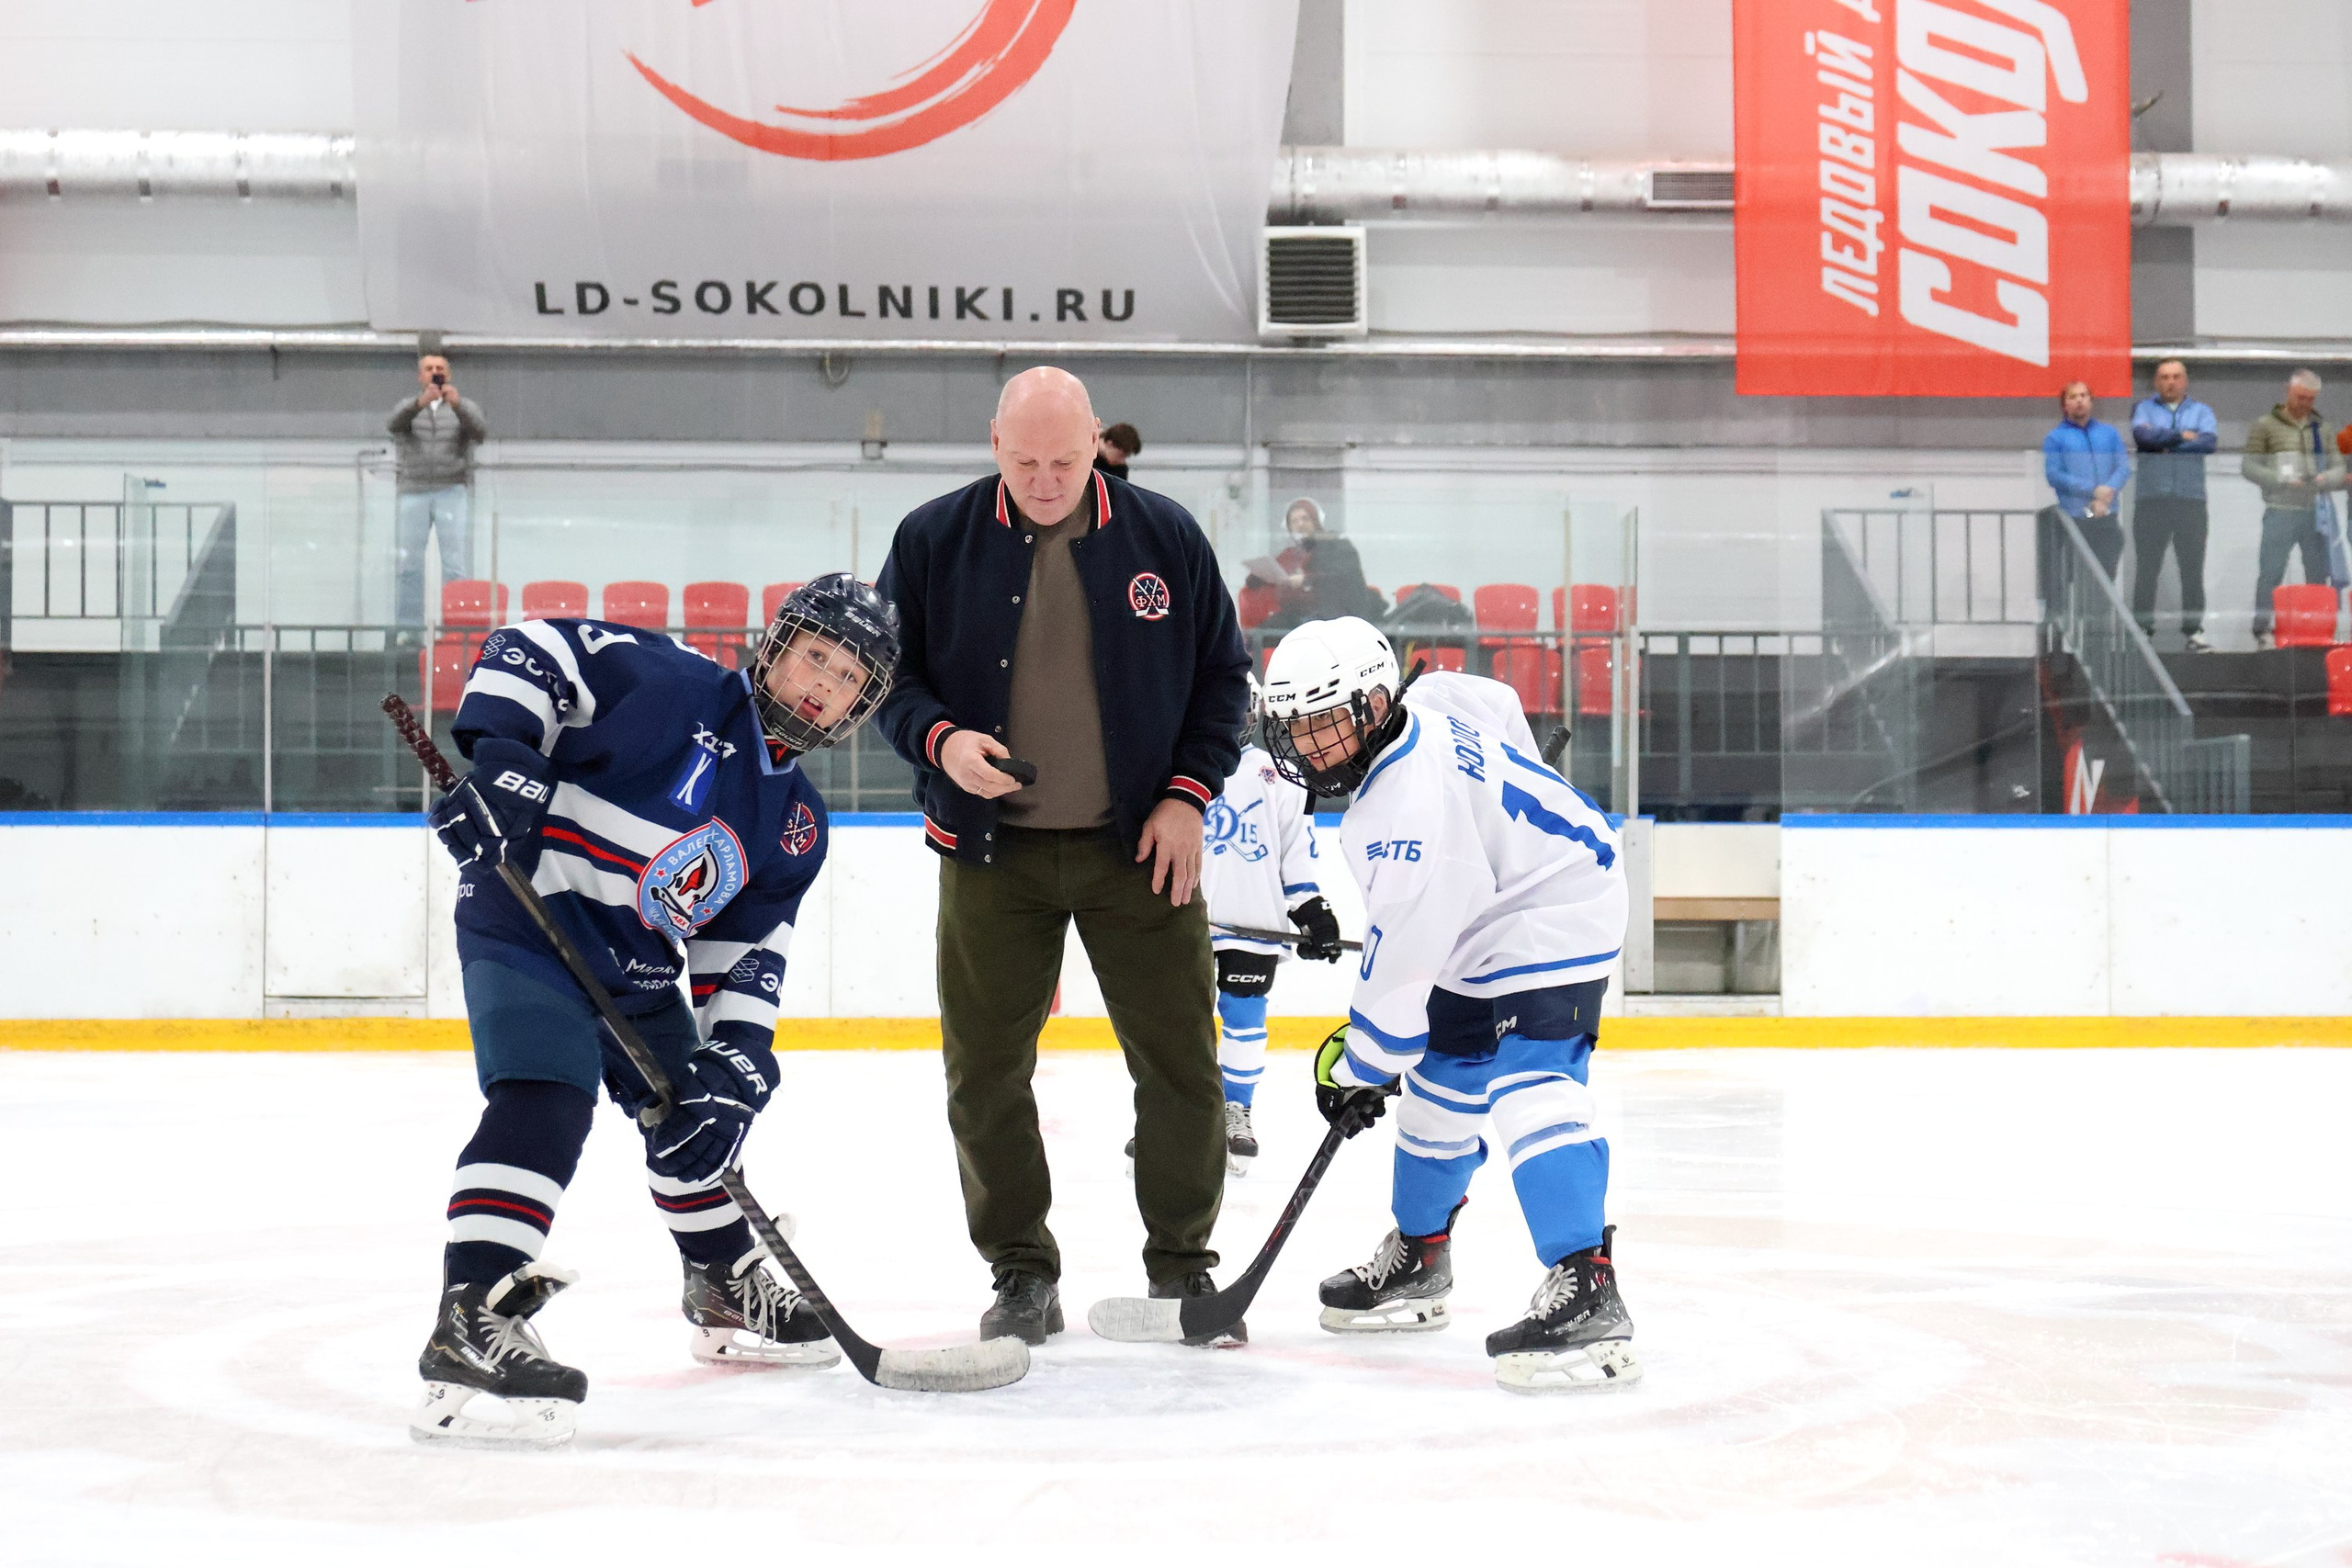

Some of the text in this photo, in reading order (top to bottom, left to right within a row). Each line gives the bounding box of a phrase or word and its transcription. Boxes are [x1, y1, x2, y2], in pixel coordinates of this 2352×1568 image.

[1804, 29, 1884, 318] ЛЕДОВЫЙ
[534, 279, 1136, 322] LD-SOKOLNIKI.RU
[1135, 593, 1166, 607] ФХМ
[1360, 661, 1385, 678] CCM
[1268, 693, 1296, 703] CCM
[1239, 823, 1259, 844] 15
[708, 829, 738, 906] ХАРЛАМОВА
[1227, 974, 1267, 984] CCM
